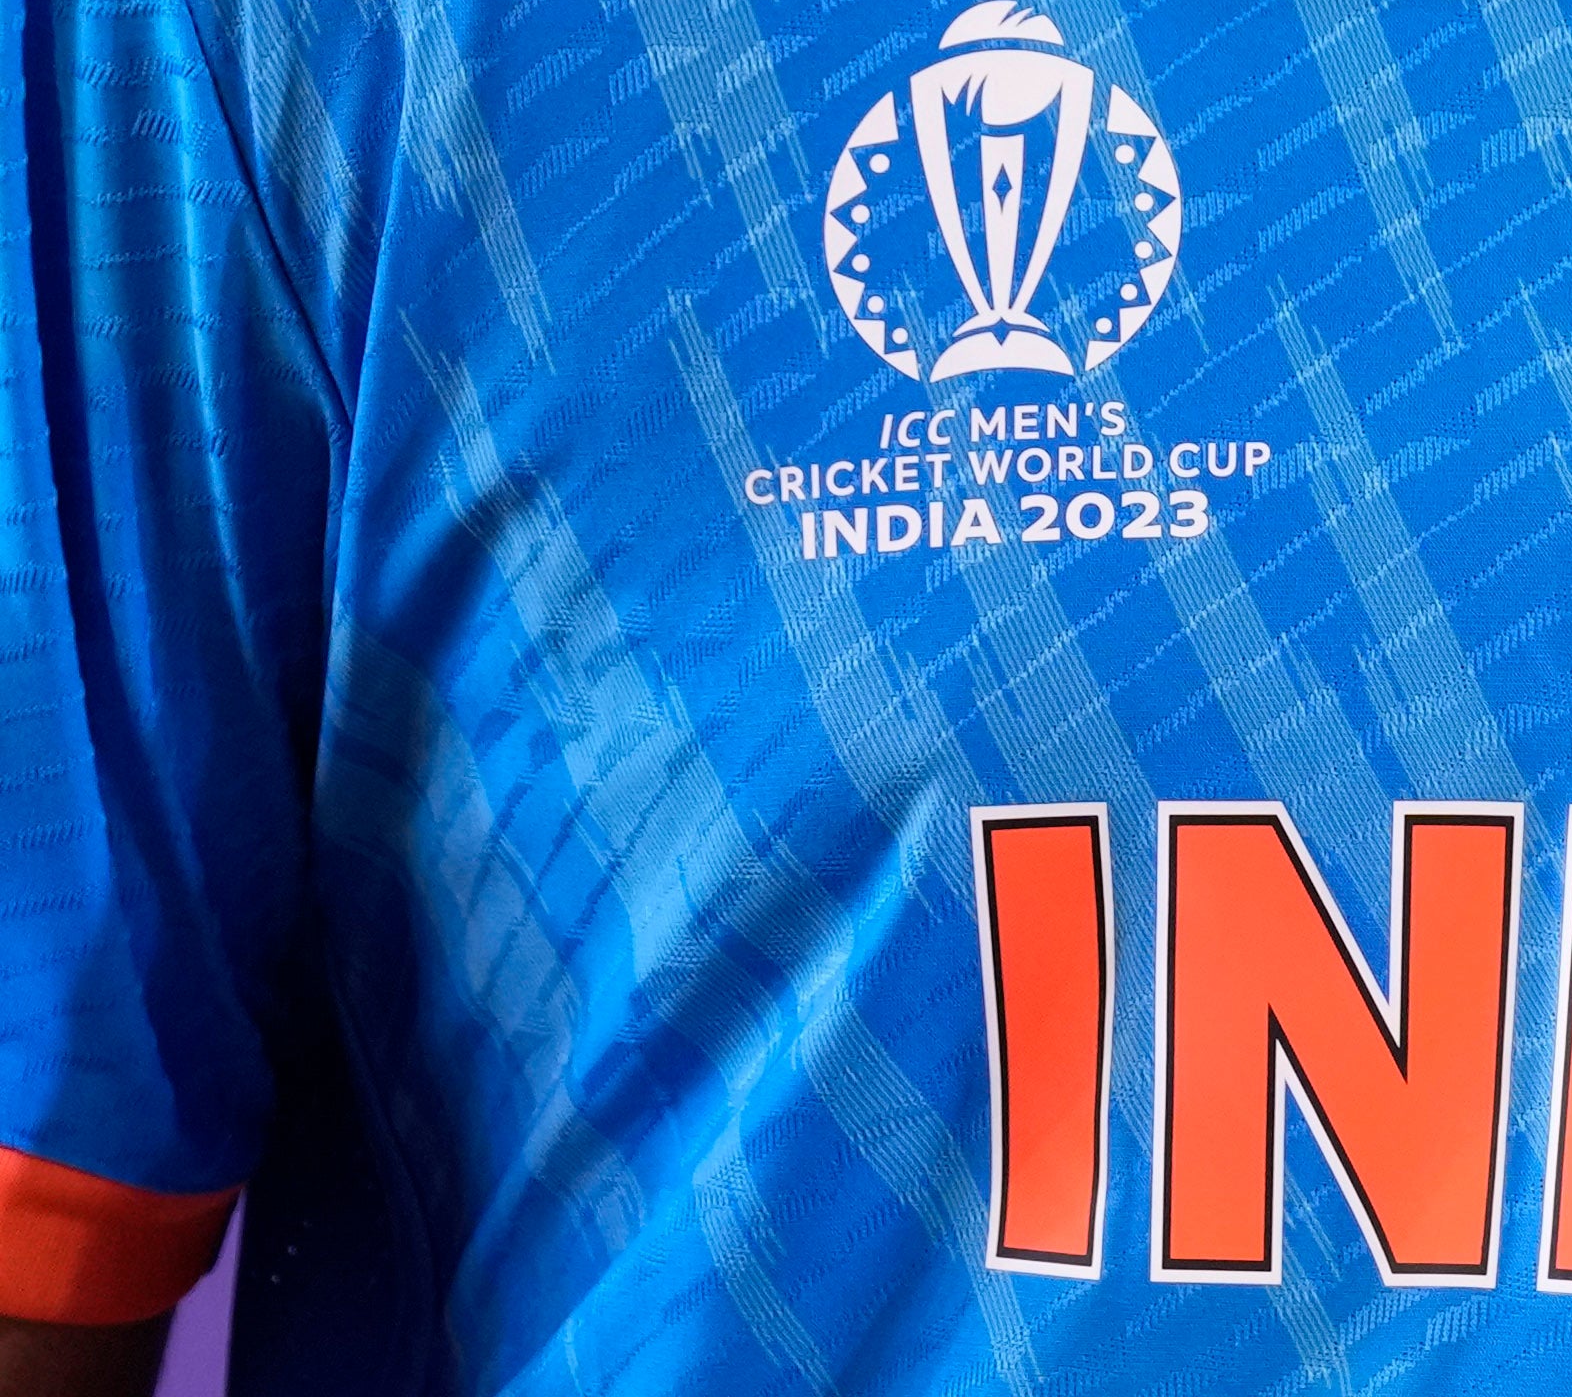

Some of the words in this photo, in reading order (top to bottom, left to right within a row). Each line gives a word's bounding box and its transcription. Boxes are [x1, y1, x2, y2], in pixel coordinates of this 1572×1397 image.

[880, 410, 955, 450] ICC
[969, 401, 1127, 443] MEN'S
[744, 453, 950, 505] CRICKET
[965, 448, 1154, 485] WORLD
[1169, 441, 1271, 480] CUP
[802, 498, 1001, 561] INDIA
[1020, 490, 1211, 542] 2023
